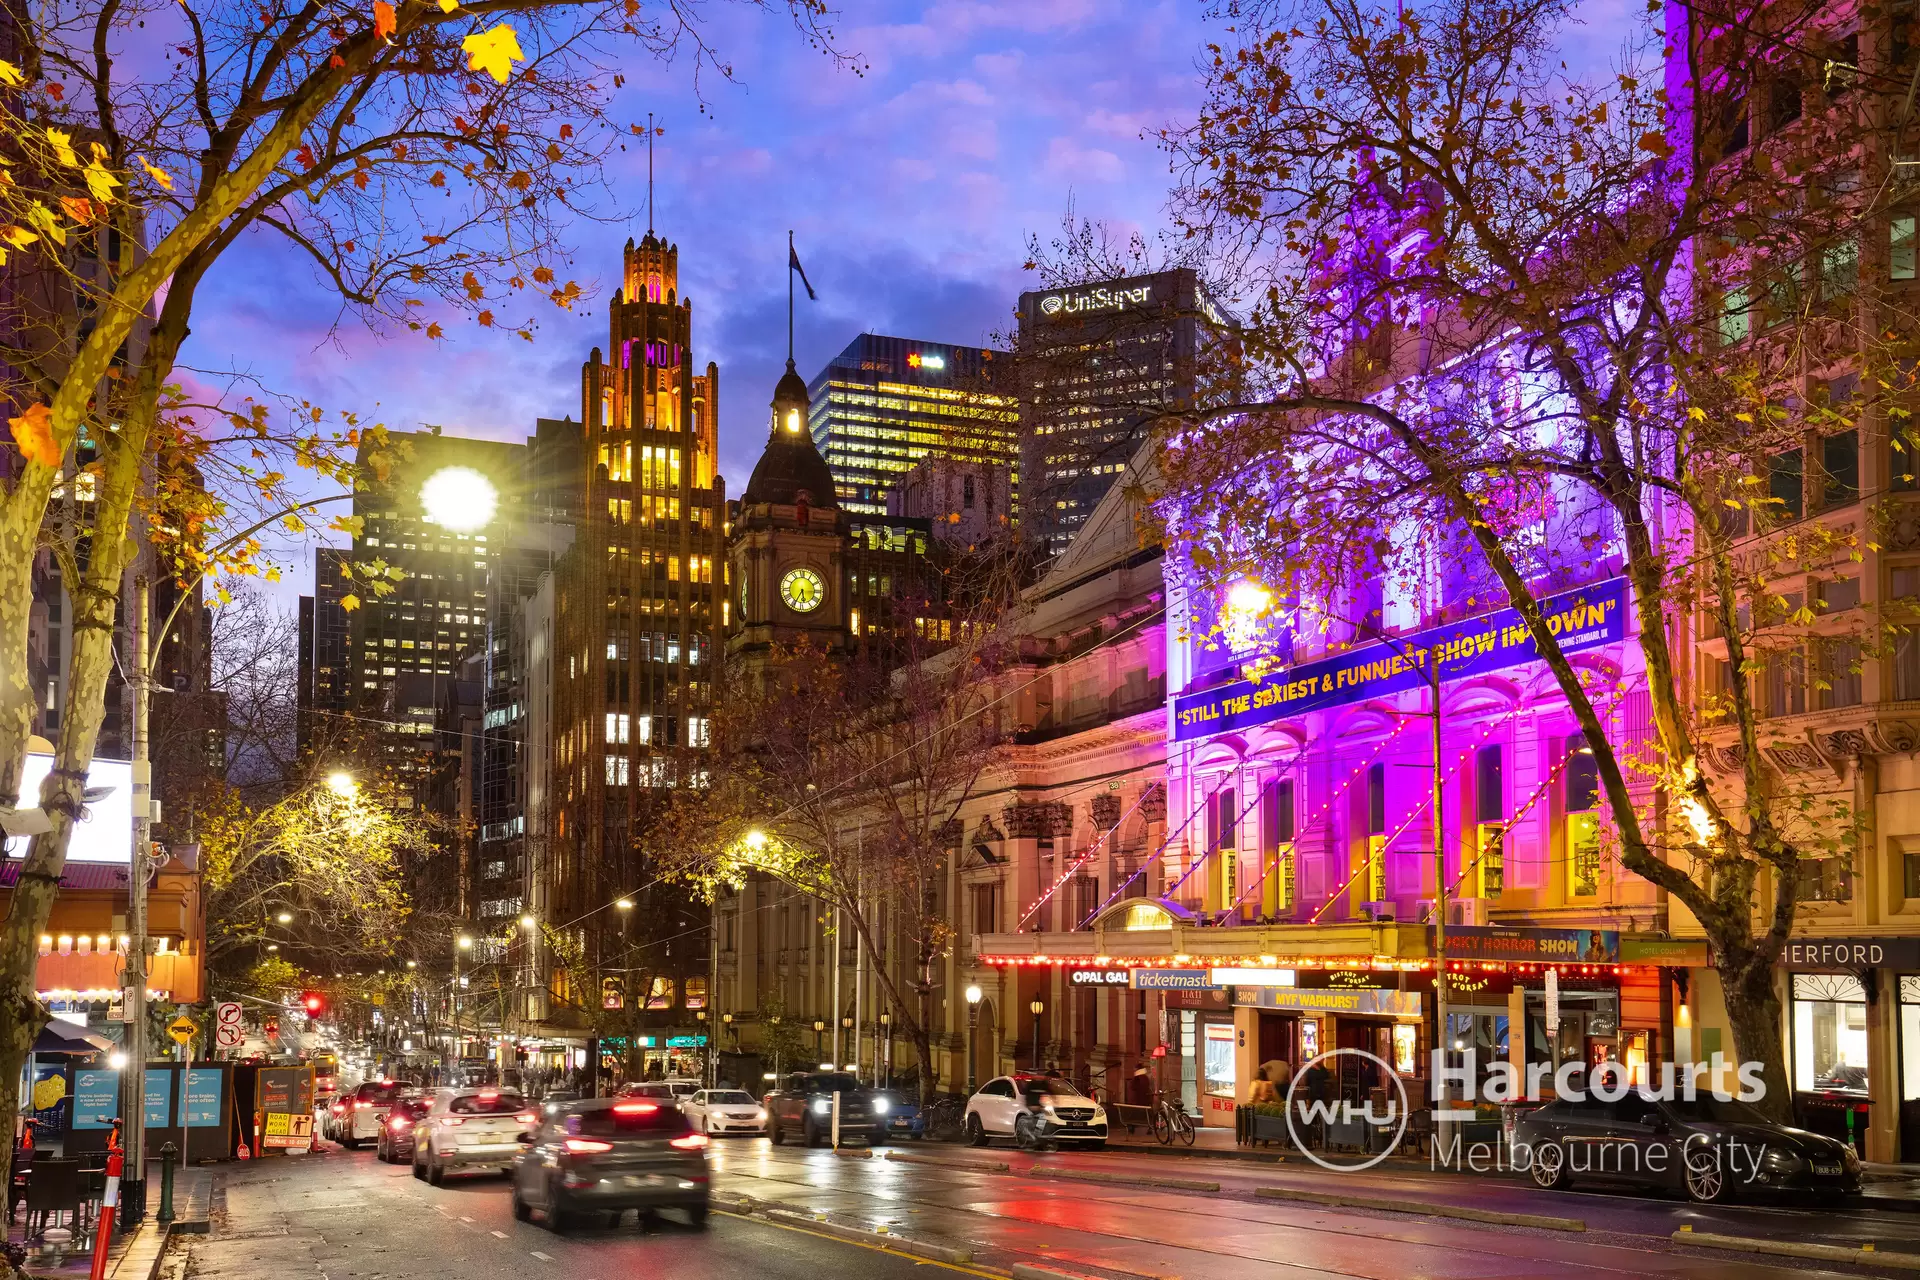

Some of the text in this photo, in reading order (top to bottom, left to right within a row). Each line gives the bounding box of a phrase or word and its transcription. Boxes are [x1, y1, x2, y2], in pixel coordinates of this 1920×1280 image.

[1064, 286, 1150, 312] UniSuper
[1555, 636, 1575, 649] VENING
[1222, 694, 1250, 715] THE
[1321, 673, 1334, 693] &
[1337, 648, 1427, 689] FUNNIEST
[1434, 630, 1497, 665] SHOW
[1502, 624, 1525, 648] IN
[1545, 599, 1616, 637] OWN”
[1484, 937, 1536, 952] HORROR
[1539, 939, 1578, 955] SHOW
[1781, 945, 1883, 963] HERFORD
[1073, 972, 1103, 983] OPAL
[1139, 973, 1216, 987] ticketmast
[1432, 973, 1470, 987] BTROT
[1238, 991, 1257, 1003] SHOW
